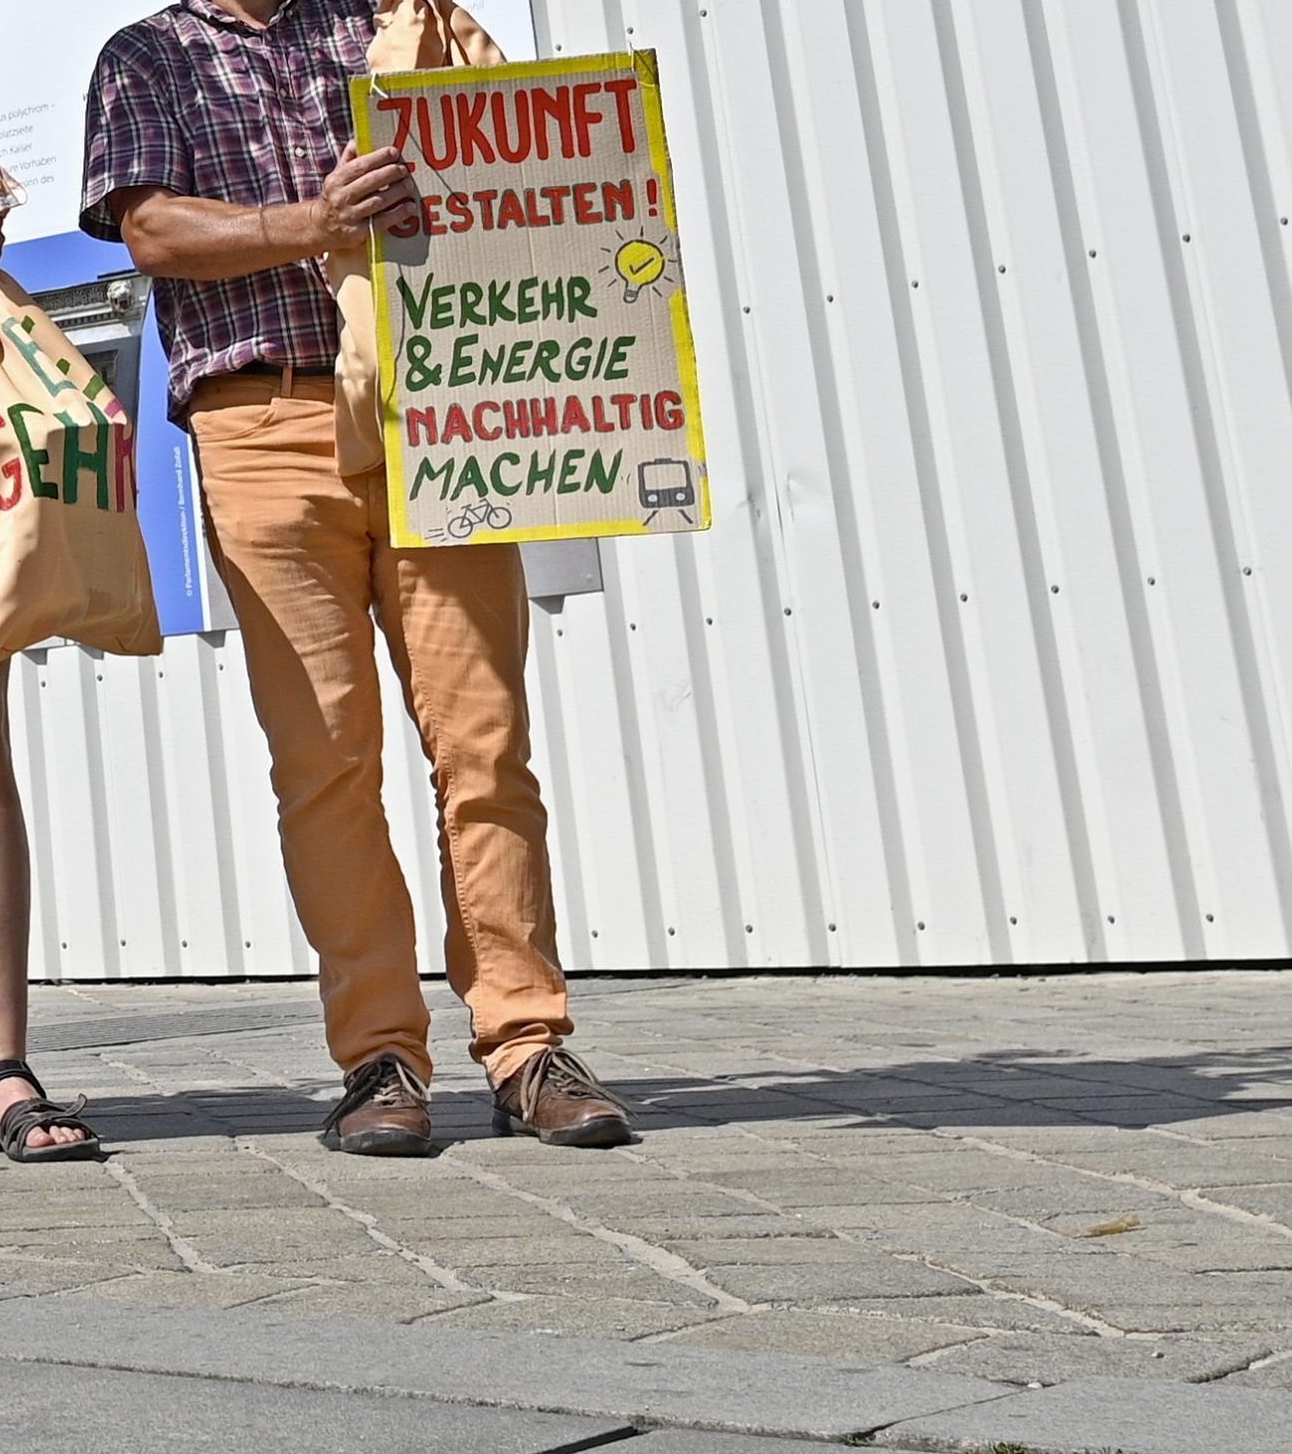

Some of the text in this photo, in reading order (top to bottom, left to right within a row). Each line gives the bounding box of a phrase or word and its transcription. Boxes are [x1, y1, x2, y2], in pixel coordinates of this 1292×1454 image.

[8, 103, 49, 121] polychrom
[376, 78, 638, 174] ZUKUNFT
[20, 156, 57, 170] Vorhaben
[395, 275, 599, 329] VERKEHR
[405, 333, 637, 391] & ENERGIE
[405, 390, 687, 447] NACHHALTIG
[408, 448, 623, 502] MACHEN
